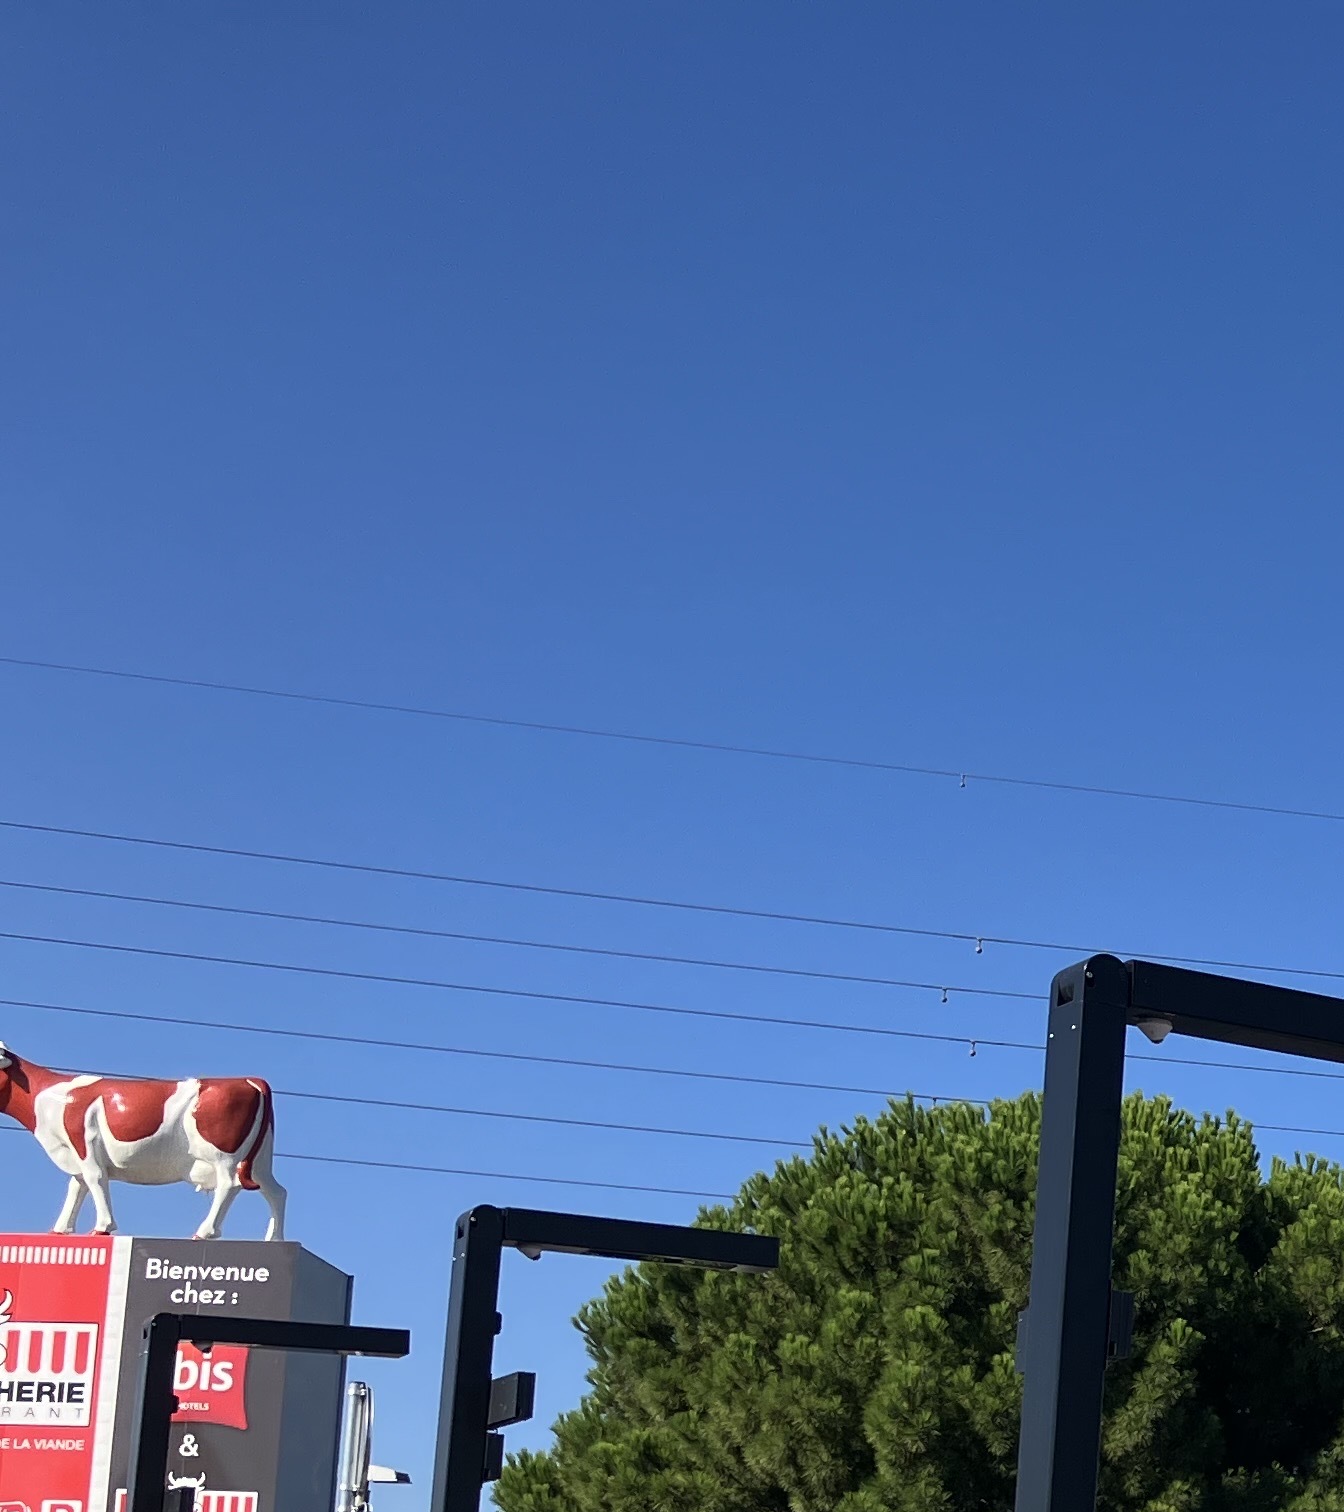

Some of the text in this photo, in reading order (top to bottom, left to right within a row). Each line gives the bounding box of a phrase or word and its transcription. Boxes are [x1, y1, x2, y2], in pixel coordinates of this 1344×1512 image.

[146, 1258, 269, 1282] Bienvenue
[170, 1281, 226, 1304] chez
[173, 1350, 233, 1391] bis
[0, 1438, 85, 1451] E LA VIANDE
[180, 1435, 199, 1457] &
